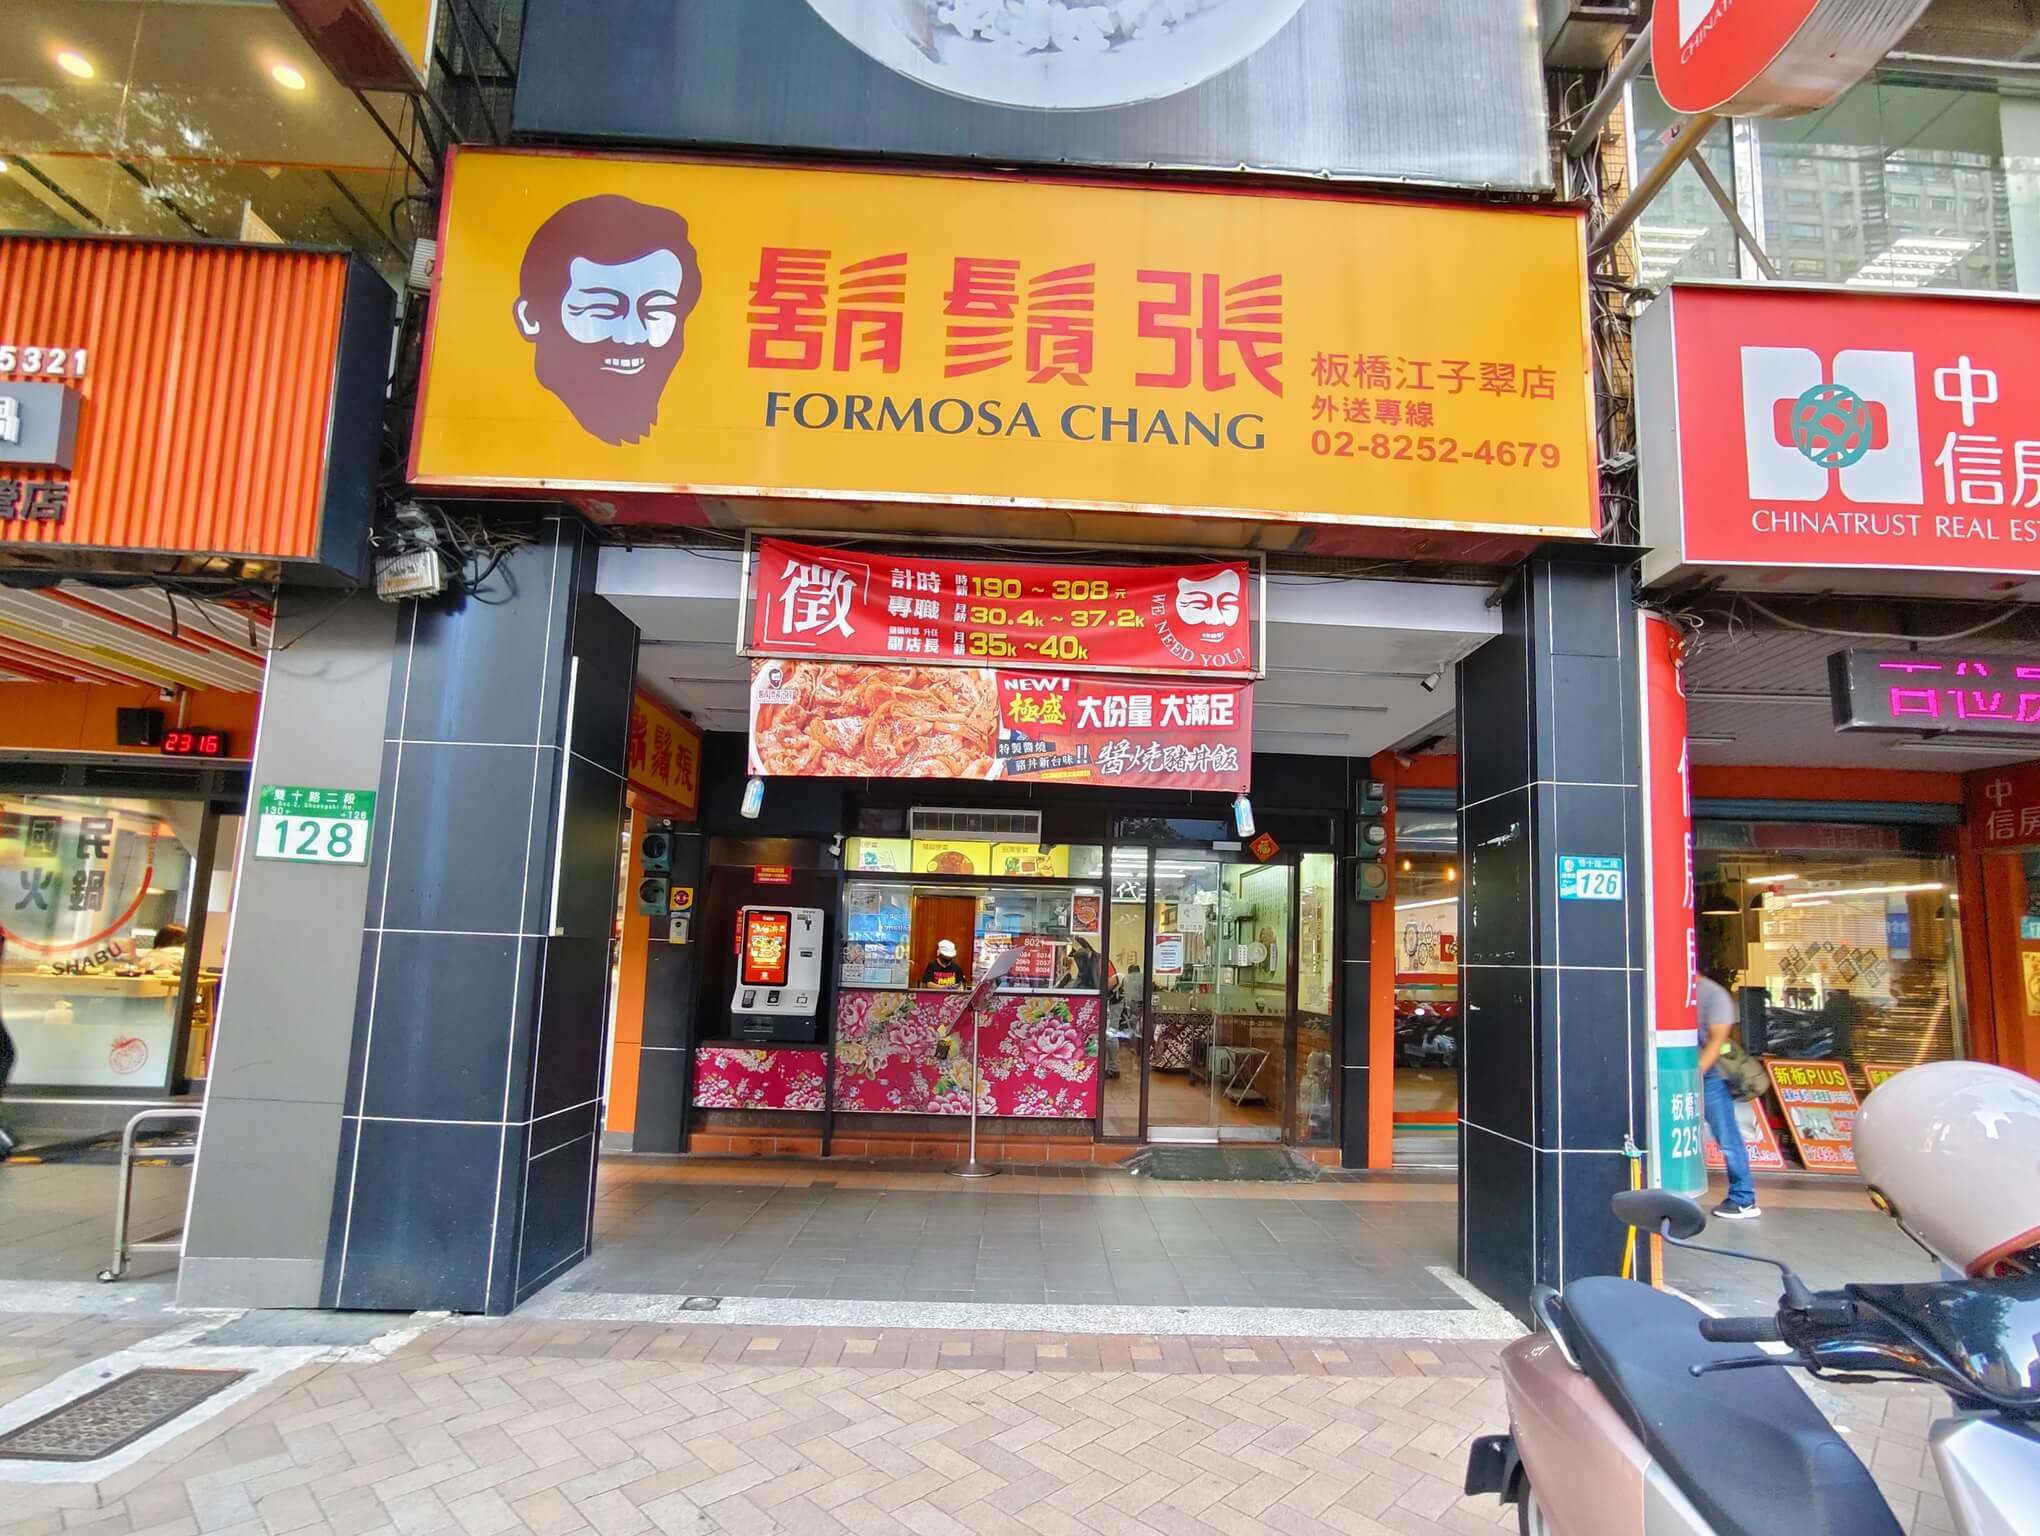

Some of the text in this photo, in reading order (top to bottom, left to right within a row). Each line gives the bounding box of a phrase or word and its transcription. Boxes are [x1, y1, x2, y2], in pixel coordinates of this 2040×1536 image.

[747, 247, 1283, 399] 鬍鬚張
[1310, 352, 1557, 400] 板橋江子翠店
[1934, 355, 1998, 427] 中
[765, 391, 1265, 450] FORMOSA CHANG
[1310, 395, 1434, 428] 外送專線
[1311, 430, 1560, 469] 02-8252-4679
[1751, 510, 1921, 536] CHINATRUST
[1936, 516, 2000, 540] REAL
[891, 568, 941, 594] 計時
[972, 576, 1021, 599] 190
[1053, 580, 1109, 600] 308
[888, 595, 940, 620] 專職
[888, 636, 940, 654] 副店長
[1152, 593, 1246, 667] WE NEED YOU!
[1004, 678, 1072, 692] NEW!
[1008, 693, 1067, 726] 極盛
[1077, 694, 1234, 729] 大份量 大滿足
[265, 806, 283, 814] 130
[275, 820, 353, 857] 128
[15, 868, 106, 912] 火鍋
[1581, 873, 1618, 894] 126
[52, 942, 122, 976] SHABU
